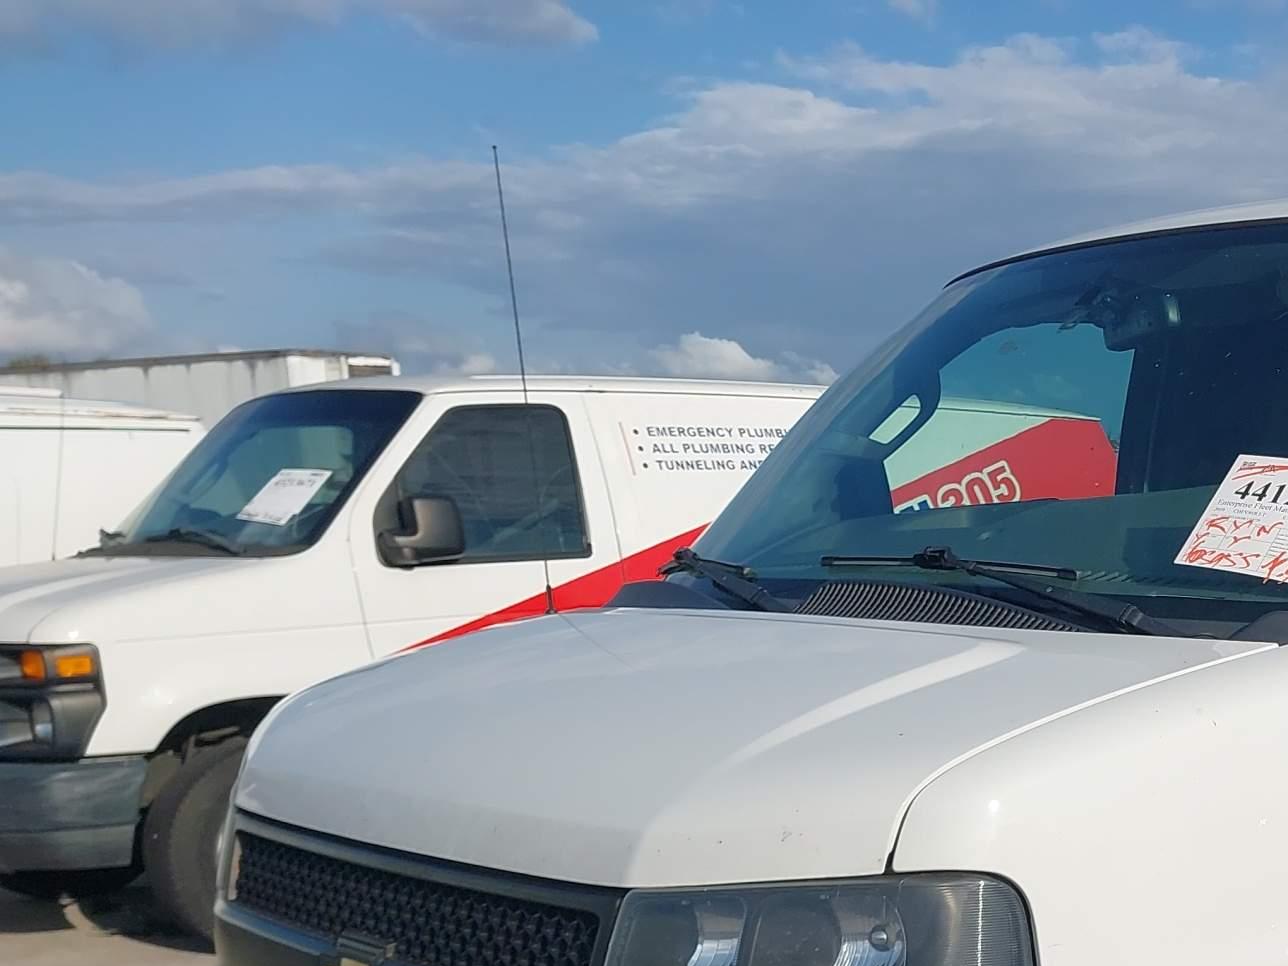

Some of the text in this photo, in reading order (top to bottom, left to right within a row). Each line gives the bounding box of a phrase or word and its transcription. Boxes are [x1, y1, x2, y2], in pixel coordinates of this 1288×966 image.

[646, 426, 733, 437] EMERGENCY
[652, 443, 679, 453] ALL
[682, 443, 755, 454] PLUMBING
[656, 460, 736, 471] TUNNELING
[1217, 498, 1253, 511] Enterprise
[1254, 501, 1273, 511] Fleet
